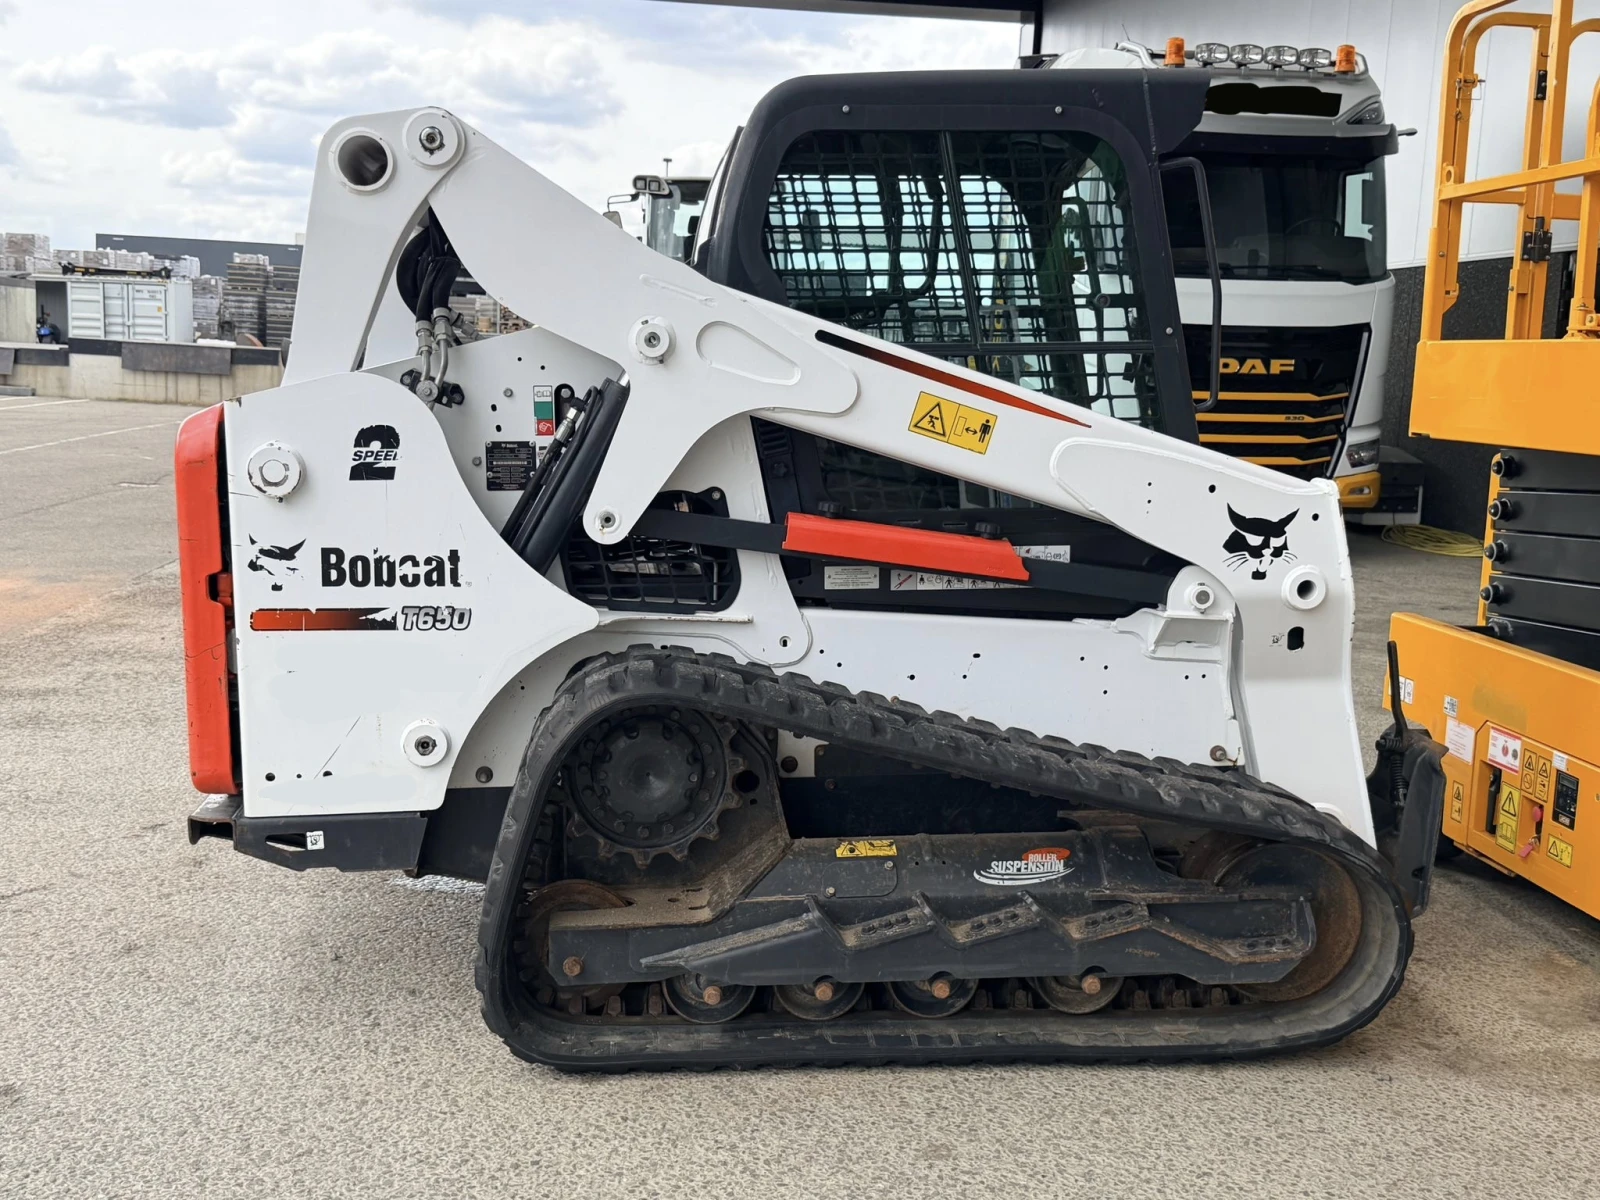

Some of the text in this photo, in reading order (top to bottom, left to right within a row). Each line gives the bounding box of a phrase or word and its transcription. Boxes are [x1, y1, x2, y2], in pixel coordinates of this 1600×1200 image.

[1220, 358, 1295, 375] DAF
[349, 424, 400, 481] 2
[320, 547, 462, 588] Bobcat
[402, 605, 472, 631] T650
[990, 860, 1065, 873] SUSPENSION
[1028, 853, 1057, 862] ROLLER
